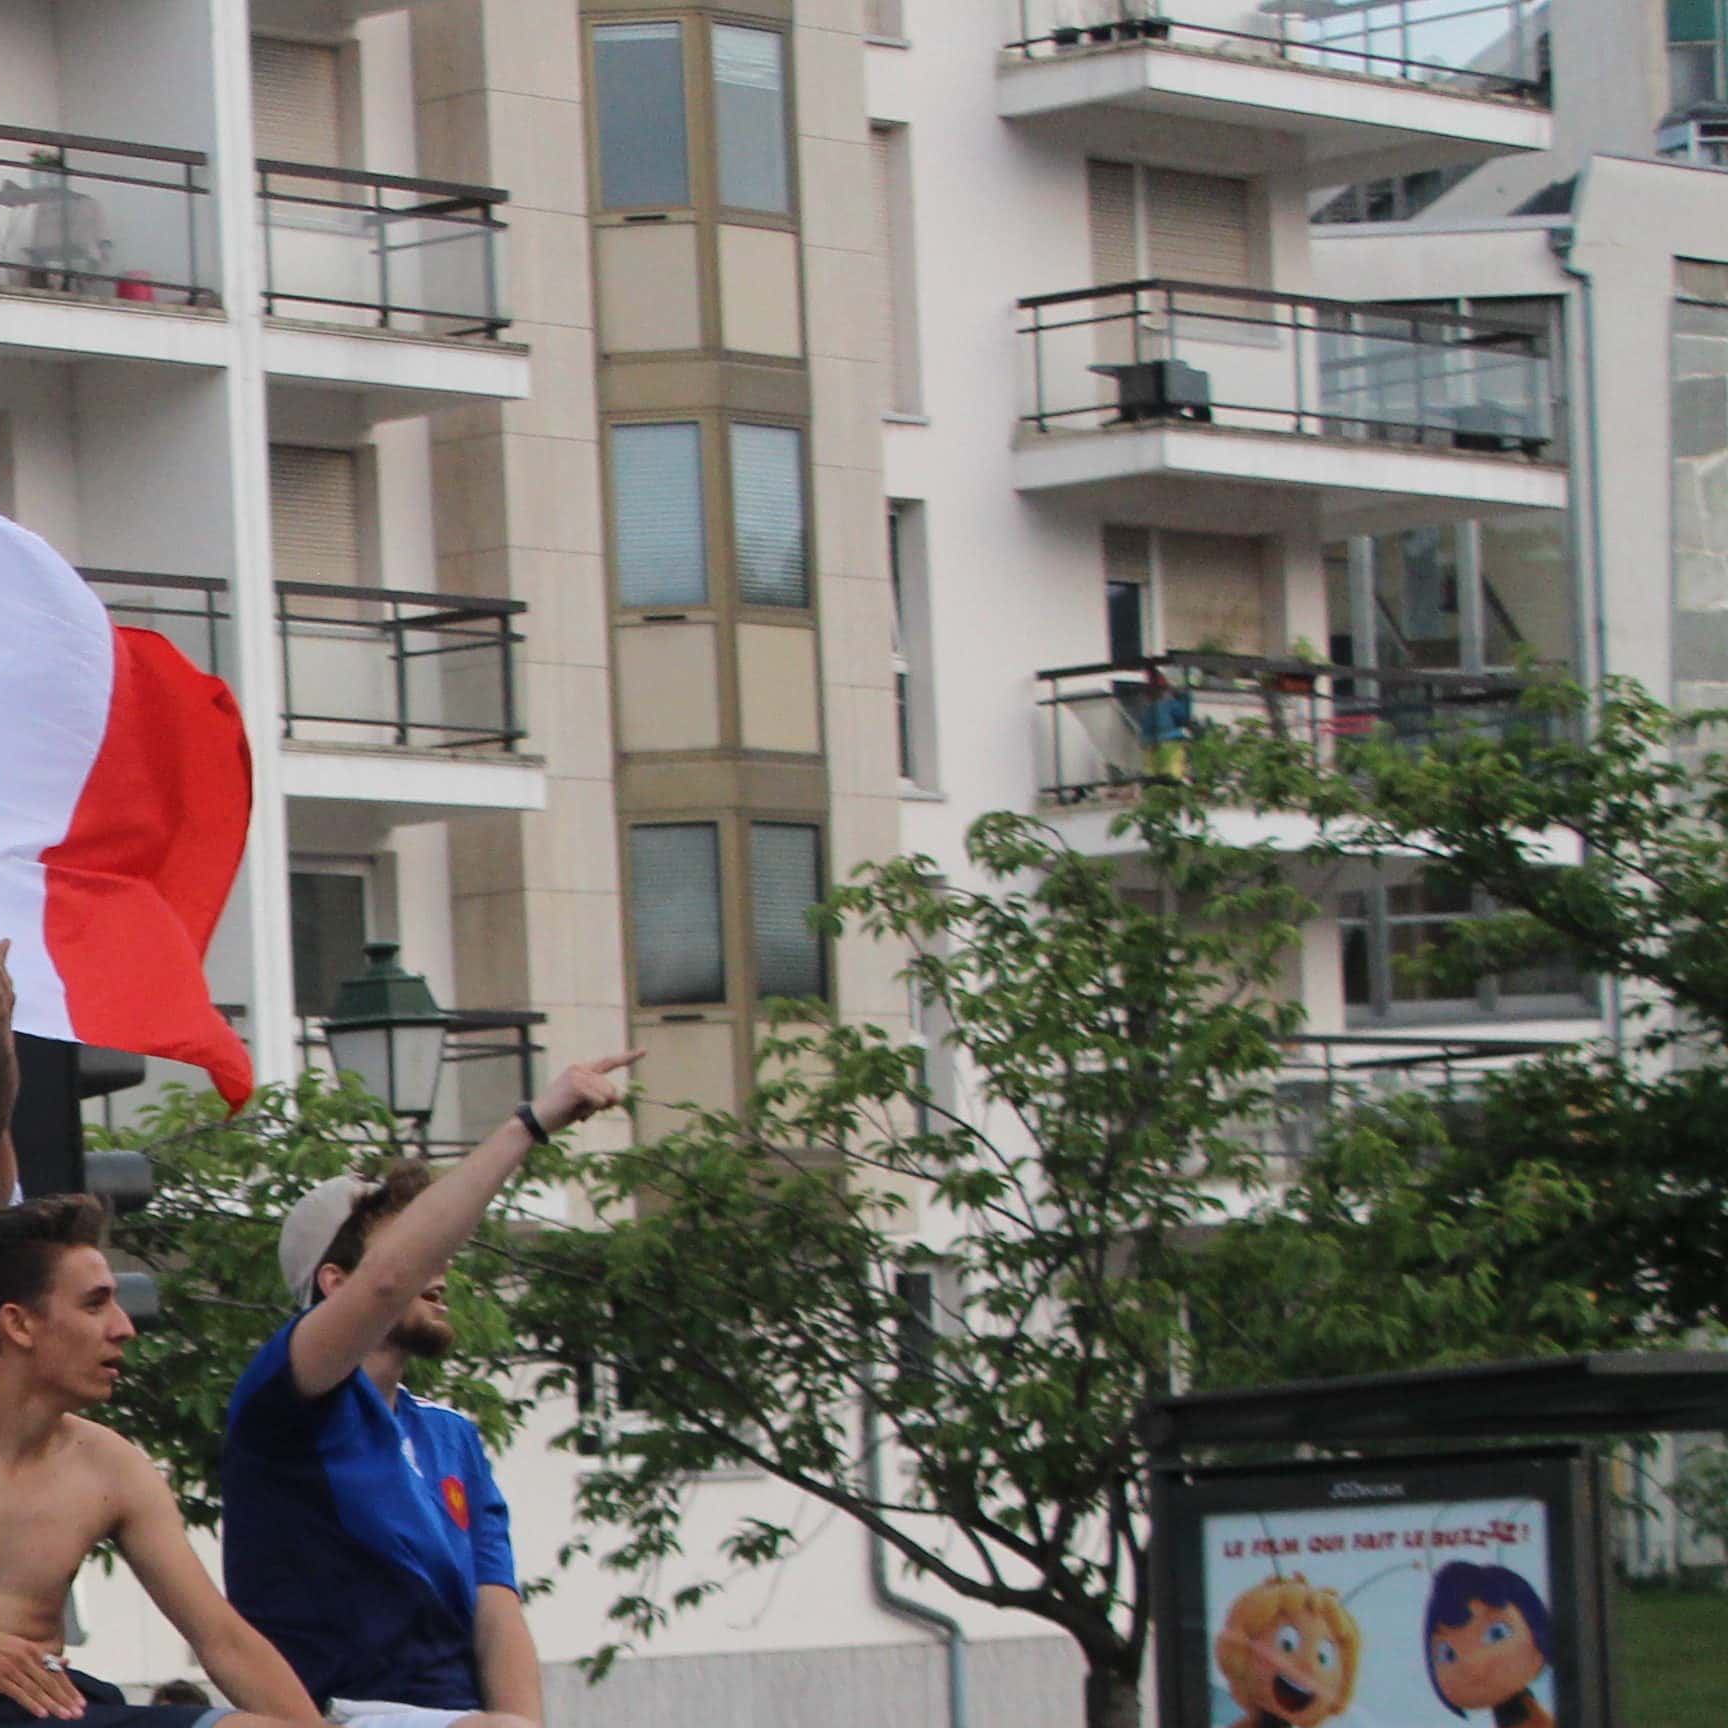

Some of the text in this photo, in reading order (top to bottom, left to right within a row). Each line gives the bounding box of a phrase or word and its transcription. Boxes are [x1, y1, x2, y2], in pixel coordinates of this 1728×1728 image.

[1224, 1540, 1243, 1558] LE
[1308, 1535, 1345, 1554] QUI
[1352, 1531, 1396, 1550] FAIT
